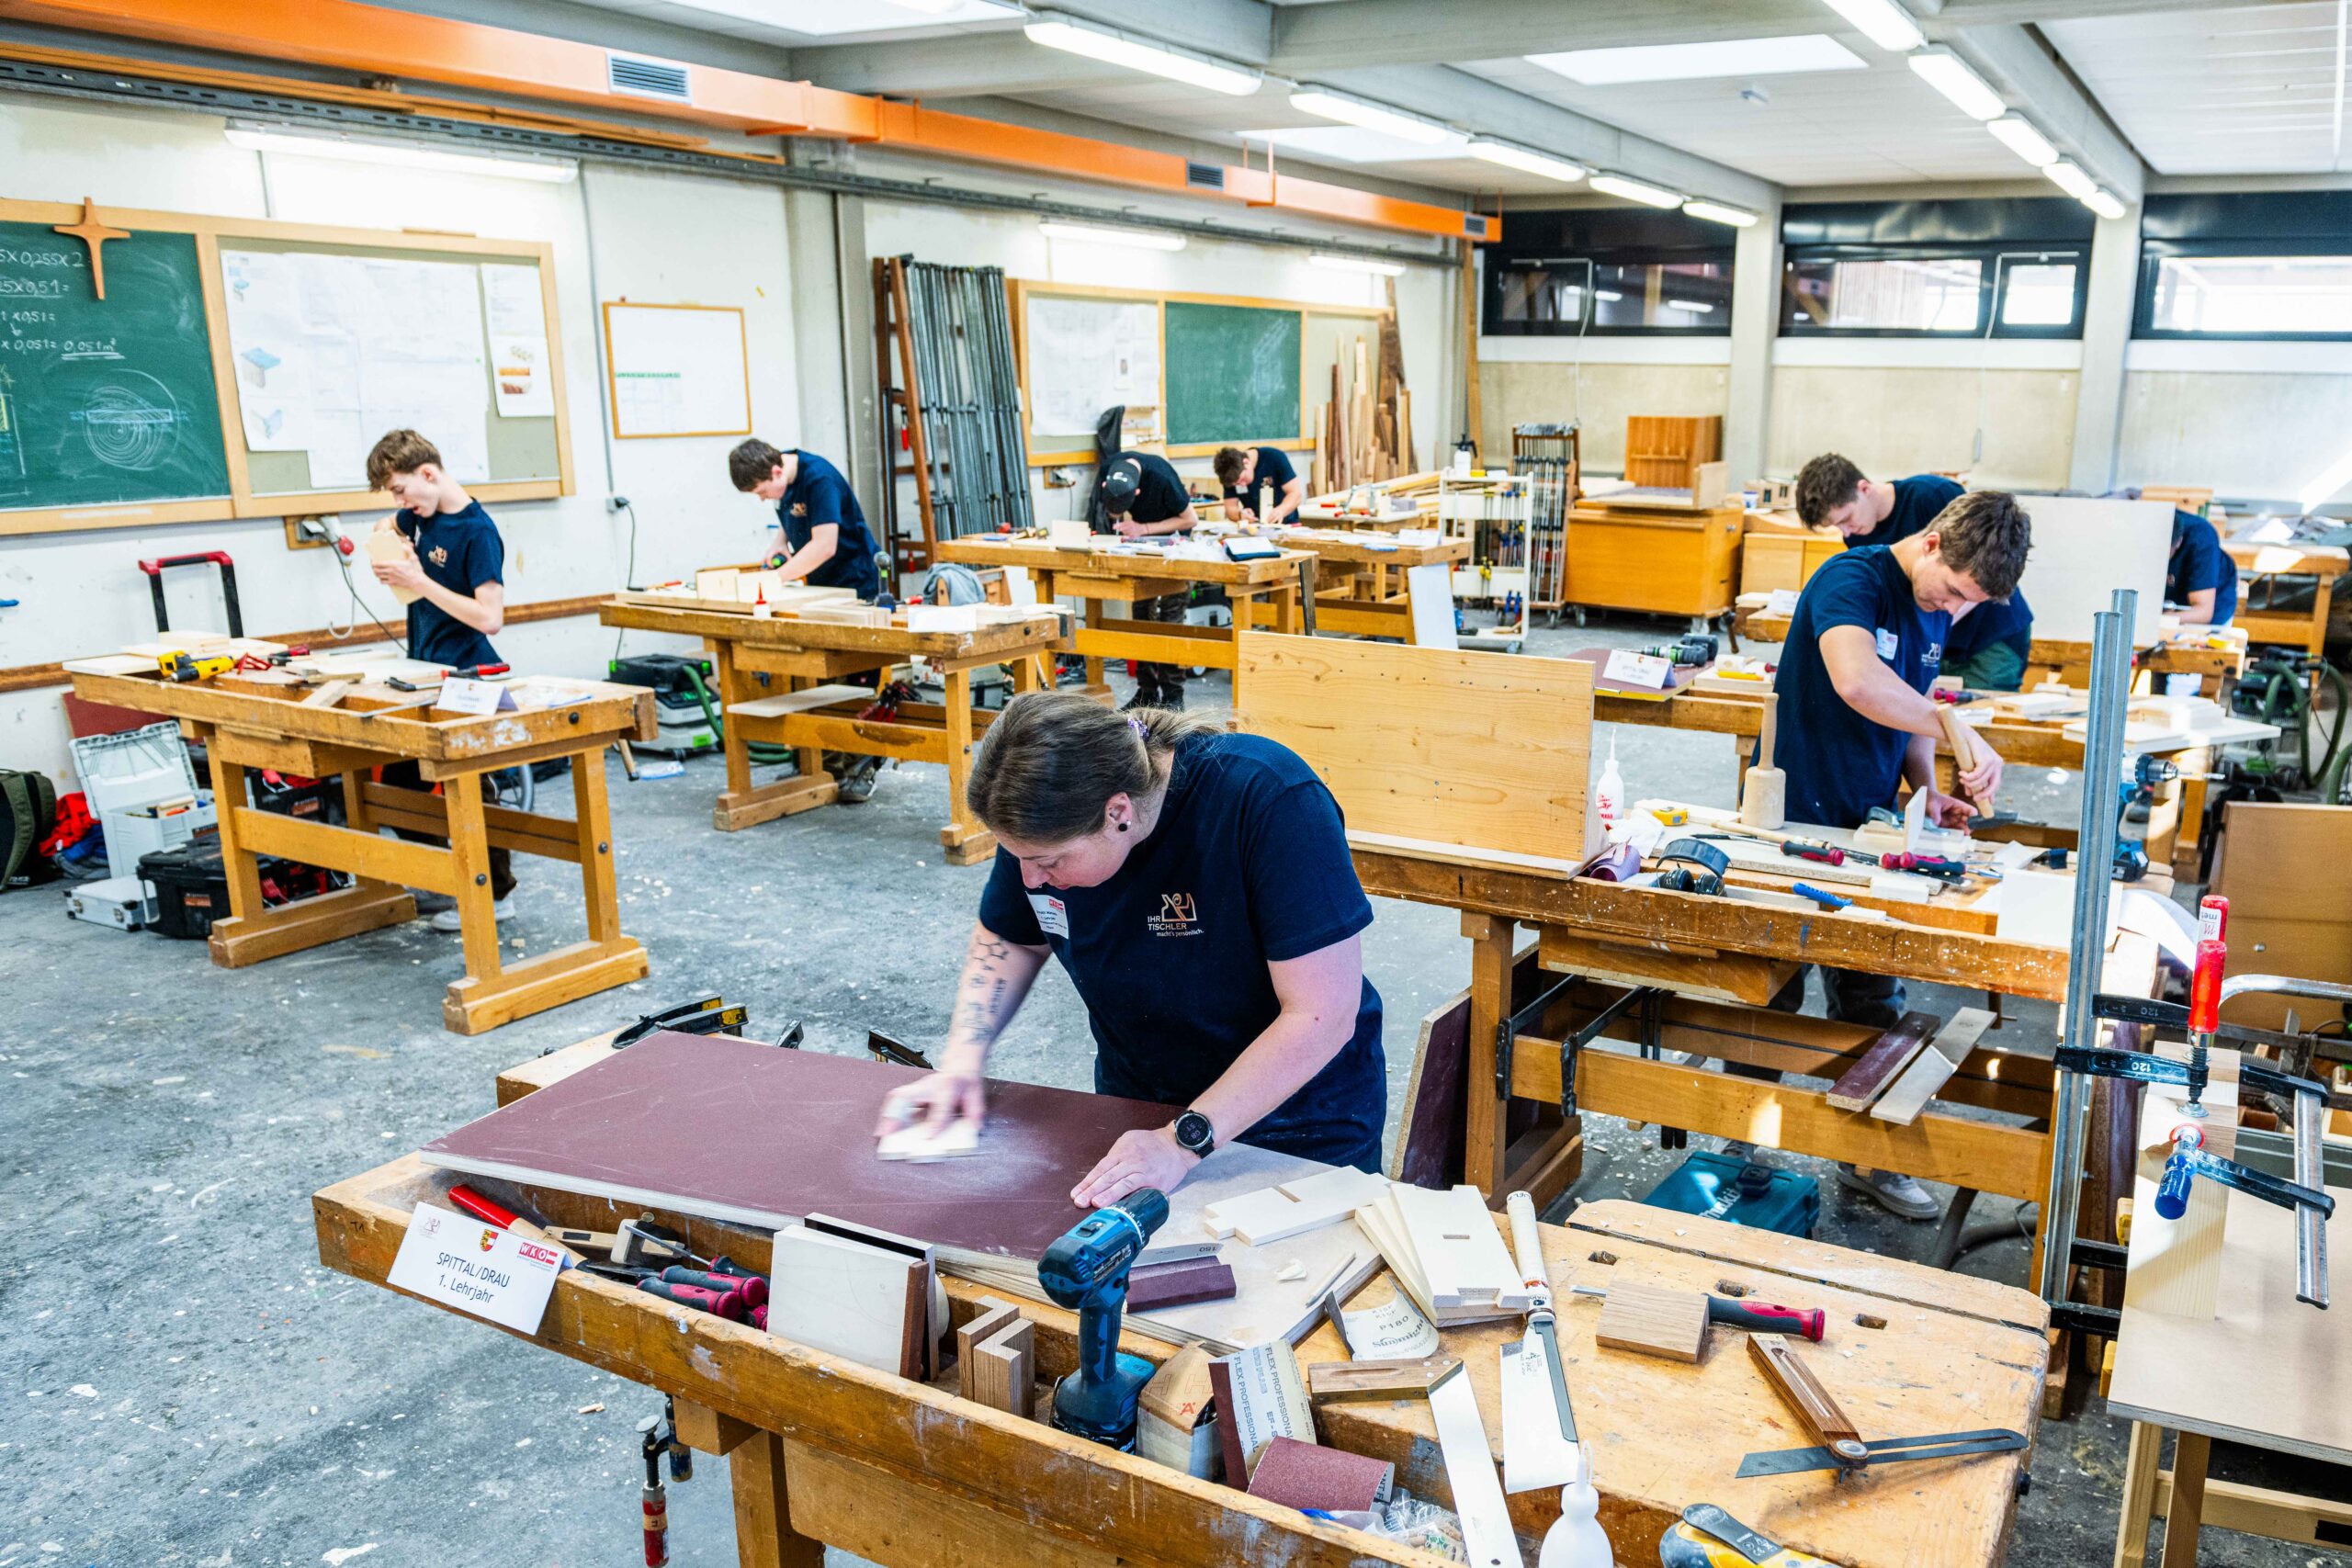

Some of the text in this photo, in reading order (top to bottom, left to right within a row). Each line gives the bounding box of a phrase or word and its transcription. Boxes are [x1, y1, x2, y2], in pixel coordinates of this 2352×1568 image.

[1176, 928, 1204, 937] persönlich.
[2140, 1007, 2159, 1017] 120
[2132, 1062, 2152, 1073] 120
[1698, 1187, 1741, 1220] makit
[520, 1242, 548, 1262] WKO
[436, 1252, 511, 1288] SPITTAL/DRAU
[439, 1274, 494, 1303] 1. Lehrjahr
[1373, 1318, 1424, 1348] Sunmight
[1233, 1352, 1244, 1381] FLEX
[1264, 1342, 1277, 1371] FLEX
[1238, 1381, 1260, 1452] PROFESSIONAL
